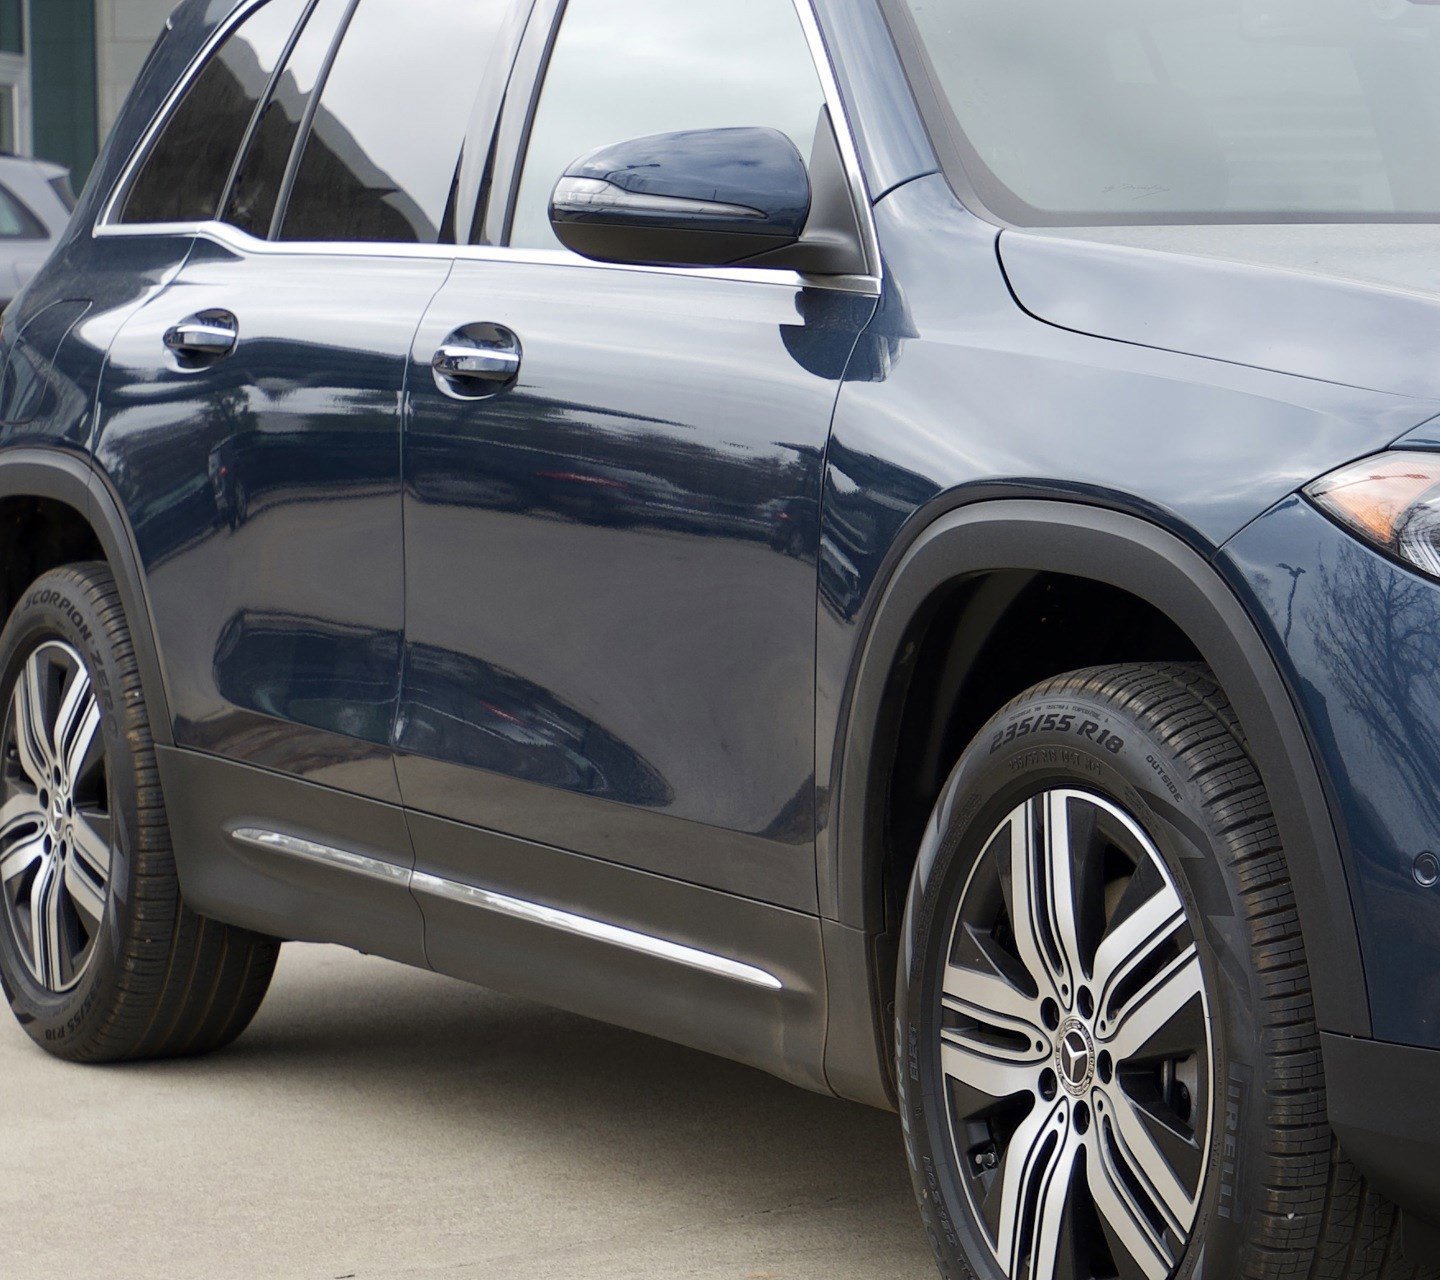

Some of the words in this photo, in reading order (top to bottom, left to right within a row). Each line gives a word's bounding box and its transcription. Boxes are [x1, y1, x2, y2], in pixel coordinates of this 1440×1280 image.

[24, 589, 92, 641] SCORPION
[989, 713, 1076, 755] 235/55
[1076, 720, 1126, 754] R18
[1145, 753, 1184, 803] OUTSIDE
